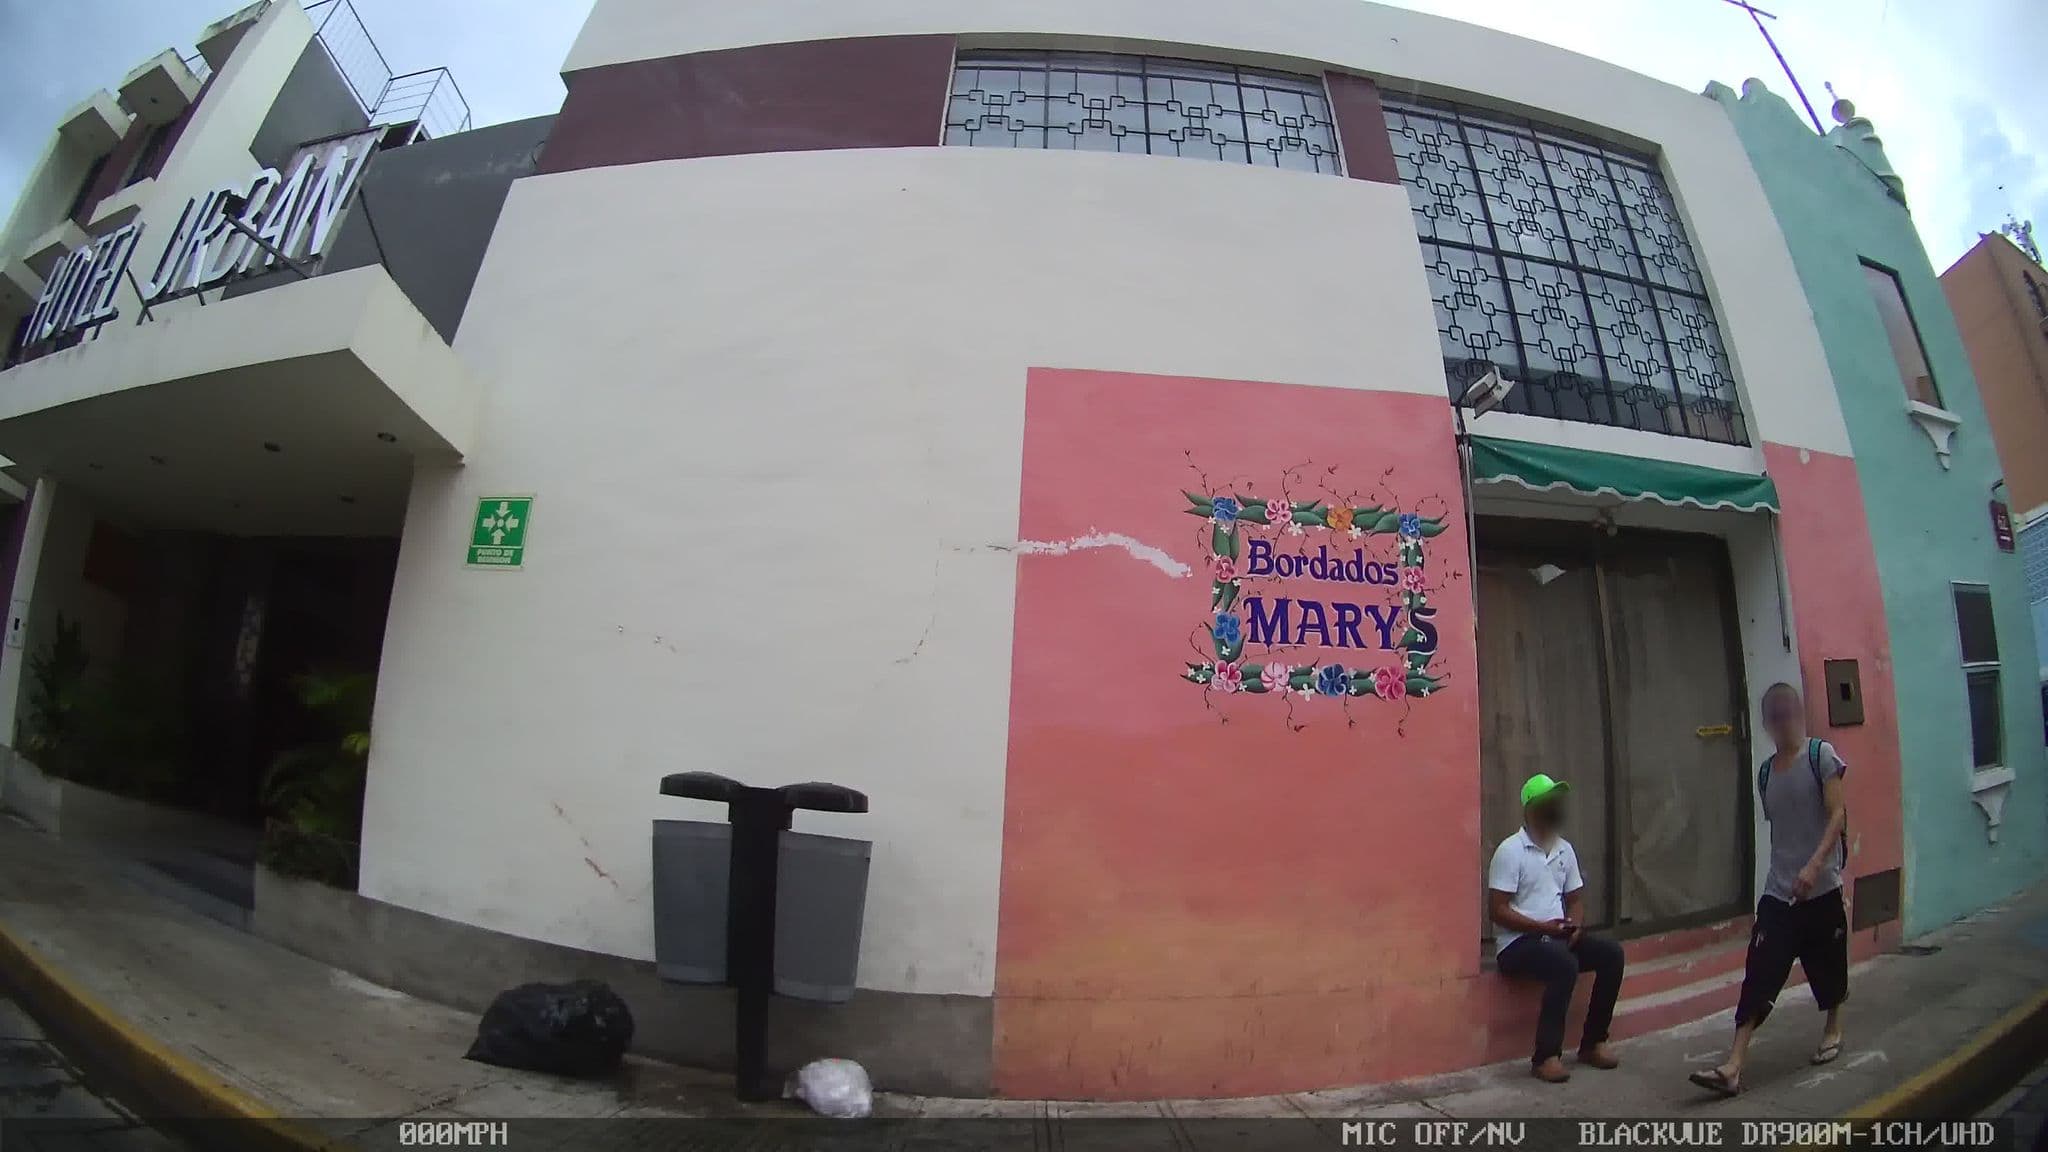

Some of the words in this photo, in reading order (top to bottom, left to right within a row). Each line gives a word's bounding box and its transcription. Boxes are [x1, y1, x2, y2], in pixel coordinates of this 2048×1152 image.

[22, 221, 146, 347] HOTEL
[143, 144, 377, 301] URBAN
[1247, 539, 1399, 586] Bordados
